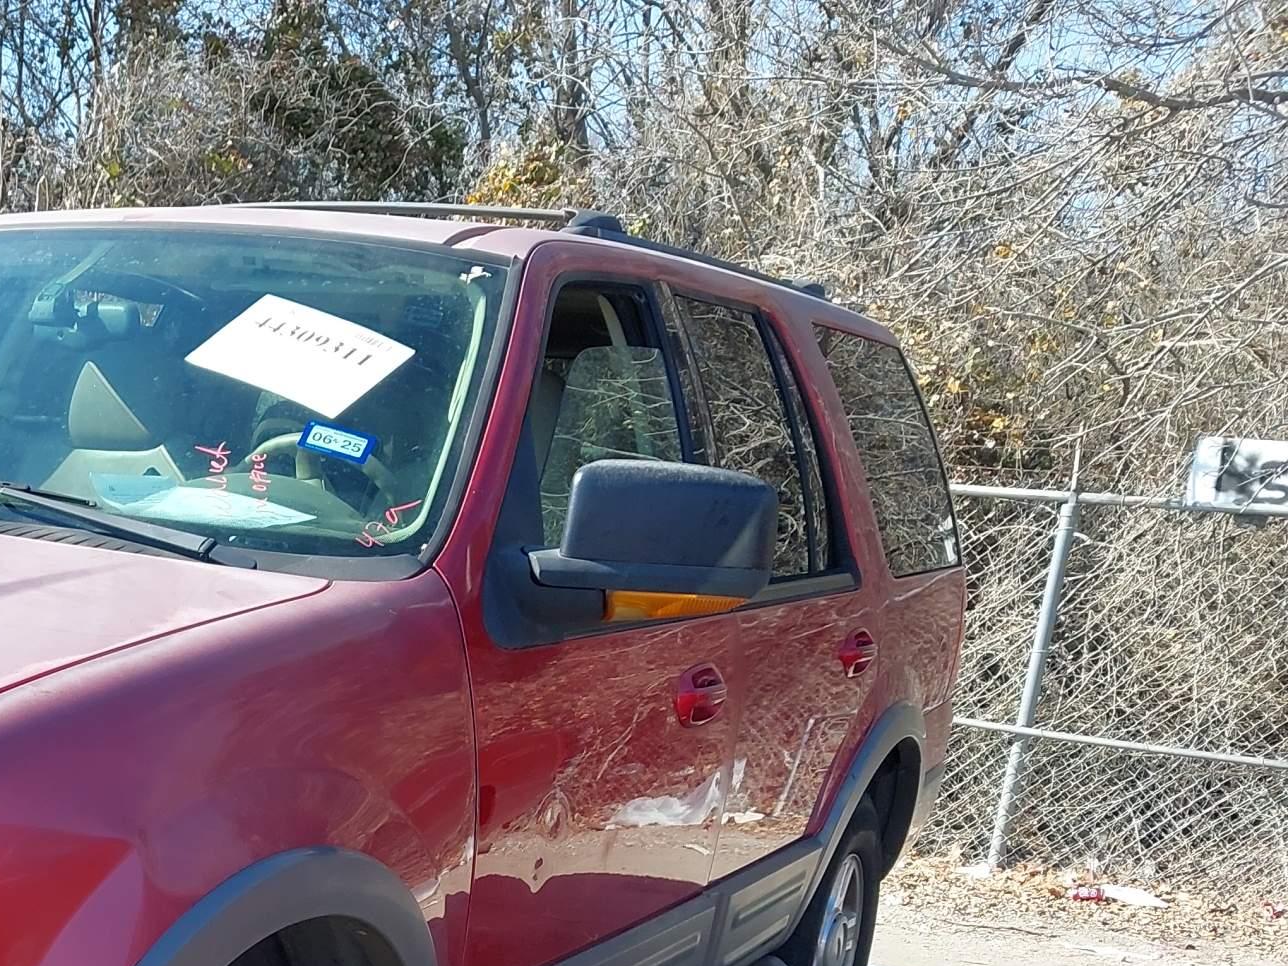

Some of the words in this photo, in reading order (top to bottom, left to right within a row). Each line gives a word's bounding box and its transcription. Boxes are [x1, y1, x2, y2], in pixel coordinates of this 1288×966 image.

[255, 316, 373, 366] 44309311
[312, 431, 333, 445] 06
[340, 440, 363, 453] 25
